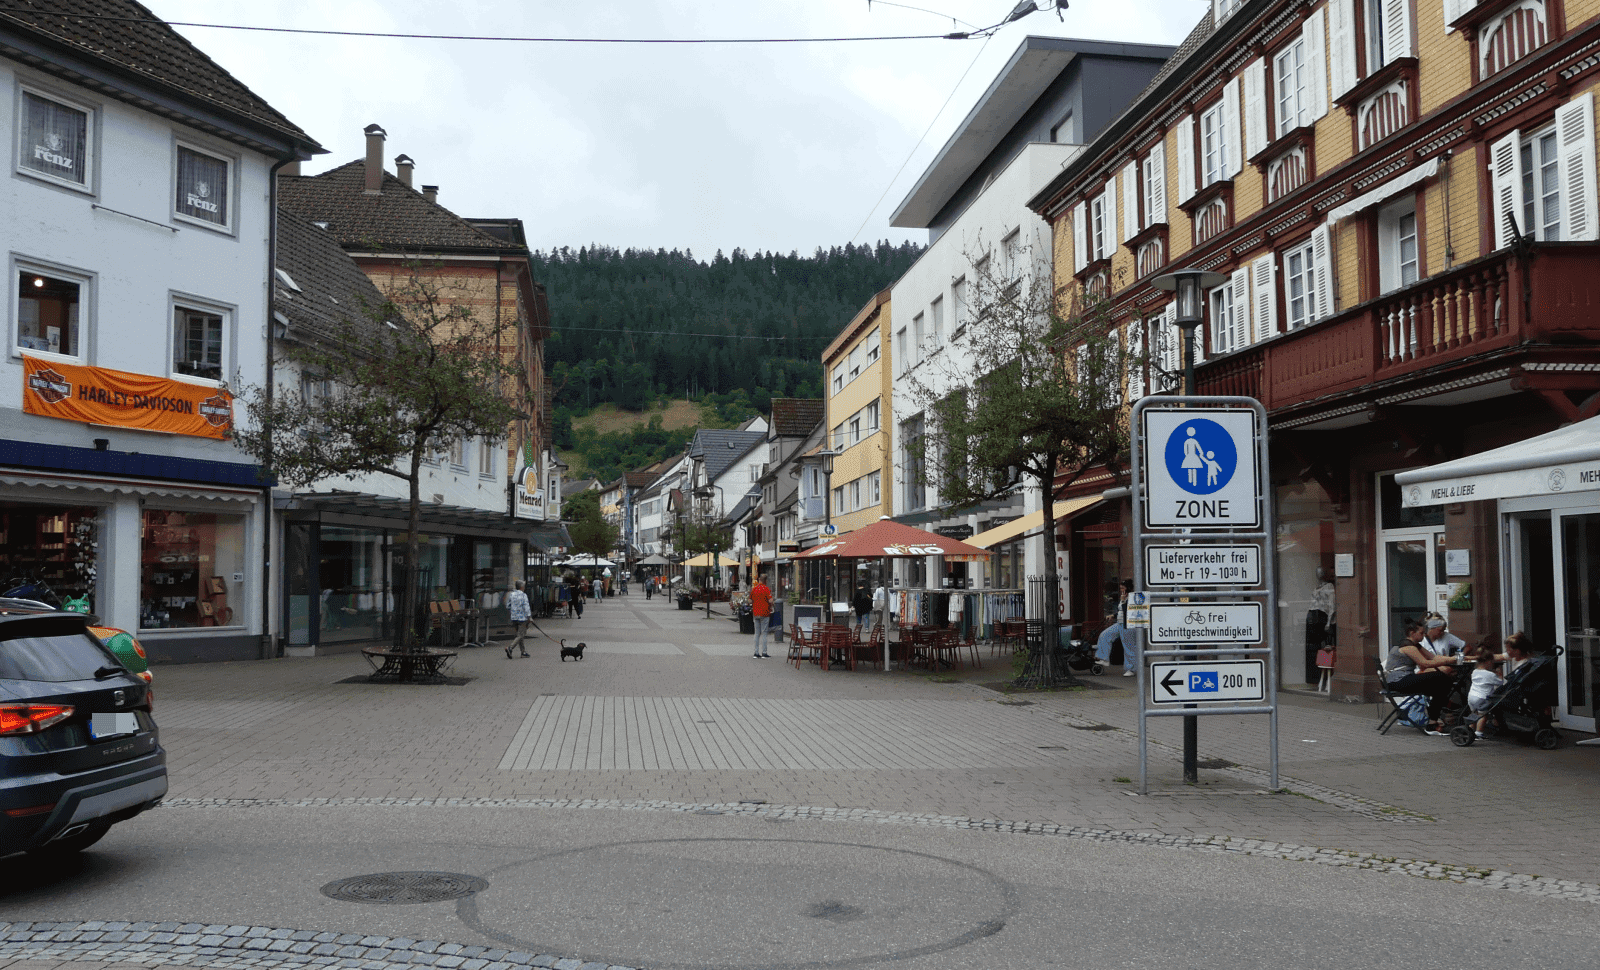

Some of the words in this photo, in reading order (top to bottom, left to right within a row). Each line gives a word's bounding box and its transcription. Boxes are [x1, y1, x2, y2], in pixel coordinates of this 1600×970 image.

[34, 148, 73, 169] renz
[187, 196, 218, 213] renz
[78, 384, 193, 415] HARLEY-DAVIDSON
[519, 490, 542, 507] Menrad
[1430, 487, 1449, 500] MEHL
[1449, 486, 1456, 497] &
[1456, 484, 1476, 497] LIEBE
[1175, 500, 1230, 518] ZONE
[1159, 551, 1226, 564] Lieferverkehr
[1231, 551, 1248, 564] frei
[1241, 567, 1248, 579] h
[1208, 612, 1227, 623] frei
[1158, 626, 1253, 640] Schrittgeschwindigkeit
[1191, 675, 1202, 690] P
[1222, 674, 1243, 688] 200
[1246, 677, 1257, 688] m
